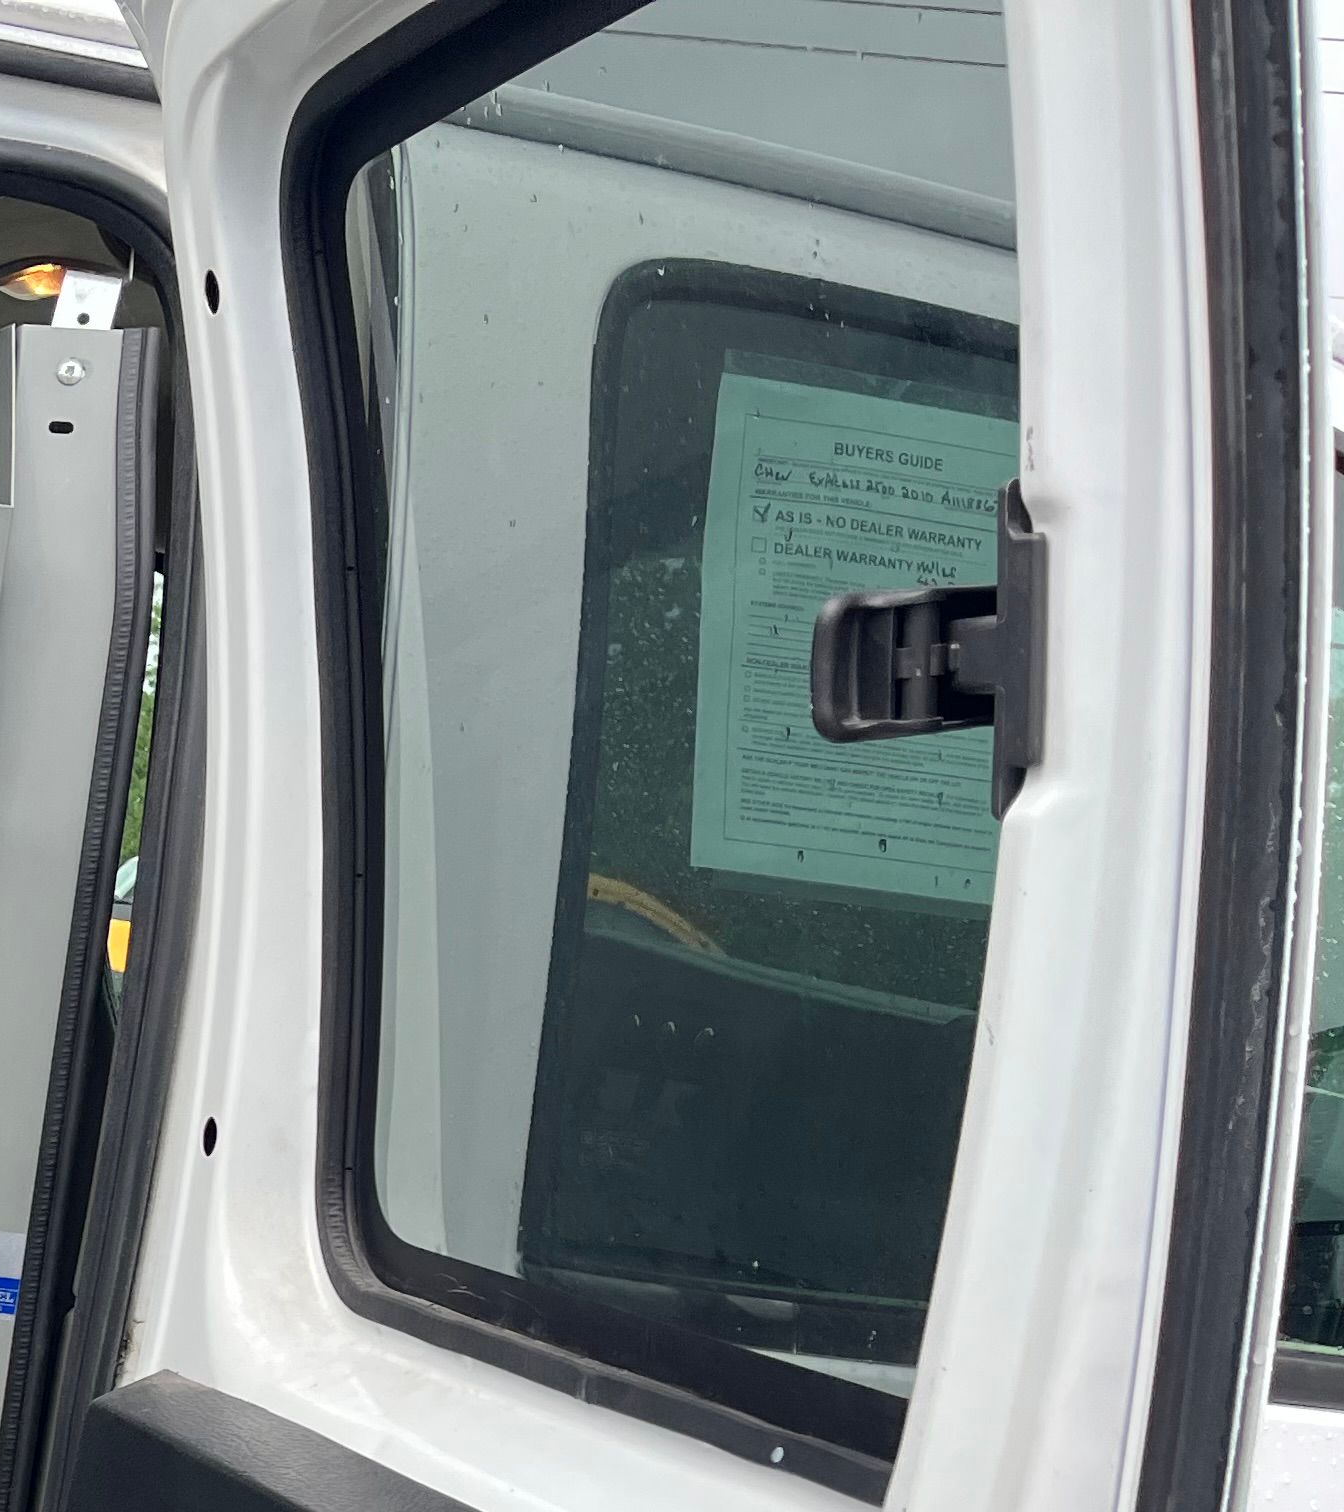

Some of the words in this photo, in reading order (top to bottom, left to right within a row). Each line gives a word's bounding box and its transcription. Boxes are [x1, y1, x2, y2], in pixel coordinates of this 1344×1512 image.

[834, 442, 894, 464] BUYERS
[898, 452, 944, 472] GUIDE
[901, 486, 934, 503] 2010
[775, 510, 794, 523] AS
[799, 511, 812, 524] IS
[825, 516, 847, 529] NO
[850, 518, 905, 538] DEALER
[906, 526, 983, 551] WARRANTY
[774, 542, 832, 560] DEALER
[836, 550, 913, 572] WARRANTY
